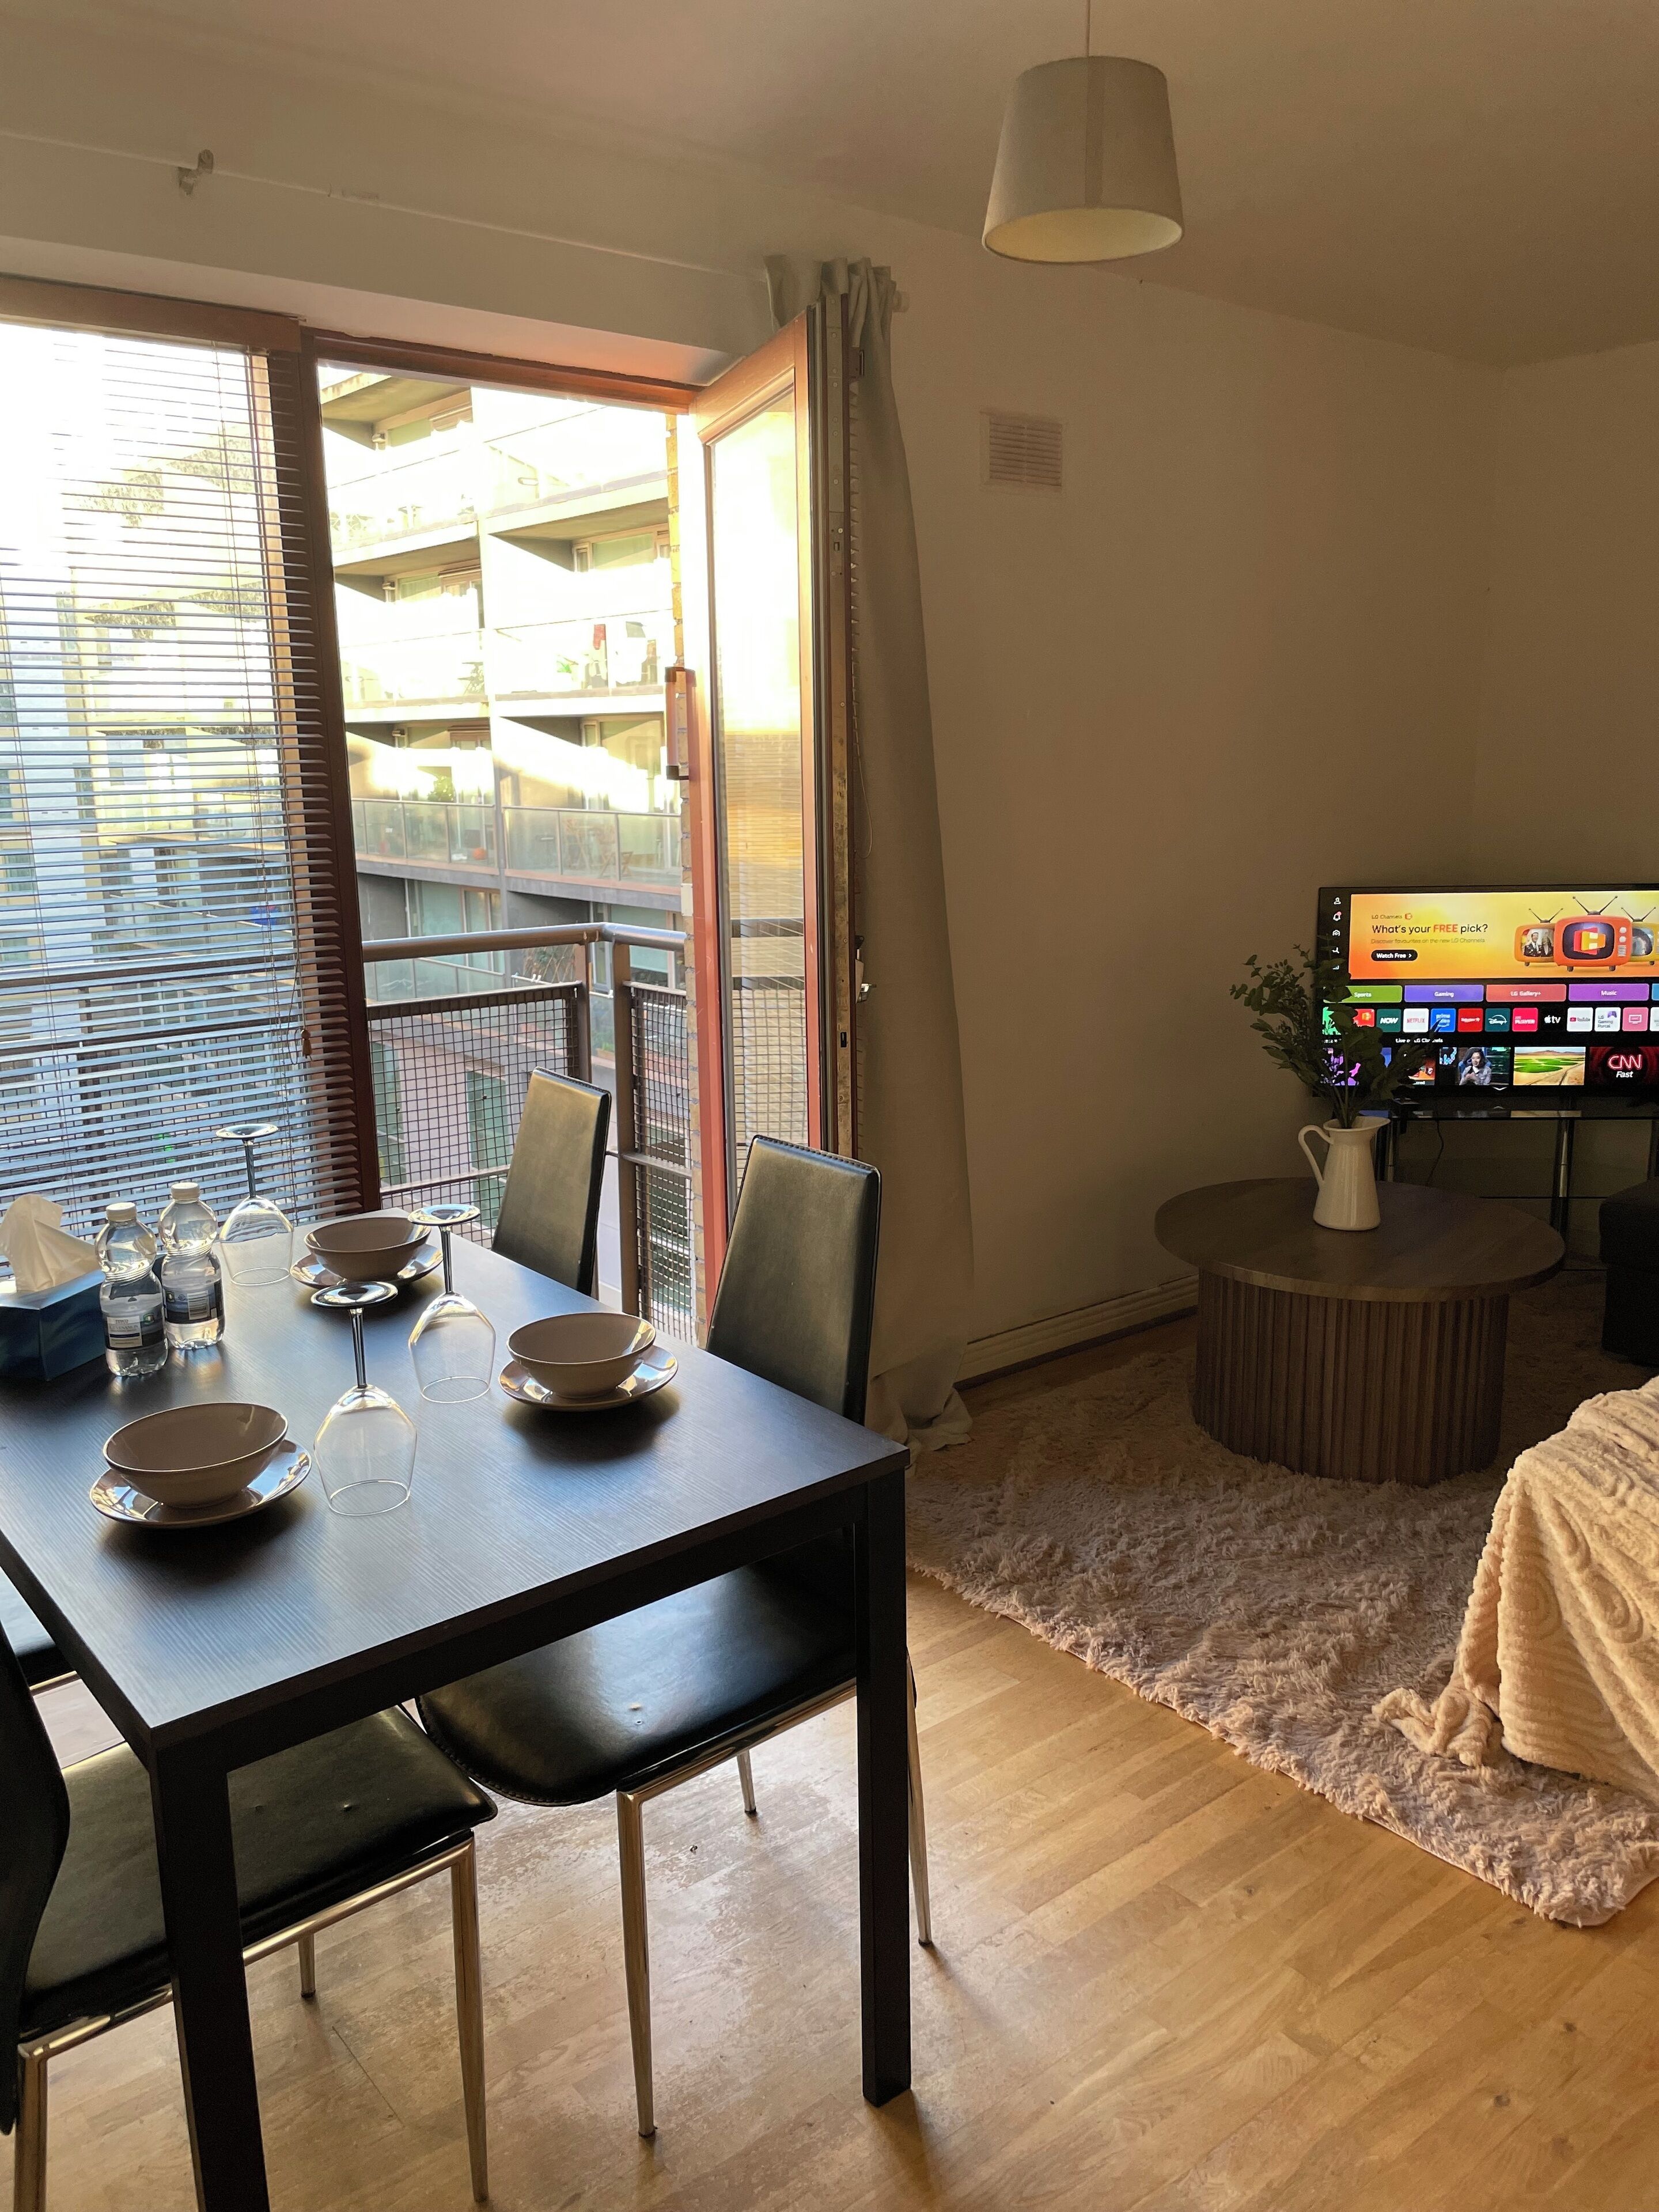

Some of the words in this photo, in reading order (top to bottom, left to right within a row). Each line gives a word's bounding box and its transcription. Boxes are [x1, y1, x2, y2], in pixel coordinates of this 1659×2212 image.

[1372, 925, 1406, 933] What's
[1408, 926, 1431, 935] your
[1433, 924, 1458, 933] FREE
[1460, 923, 1488, 934] pick?
[1608, 1054, 1642, 1070] CNN
